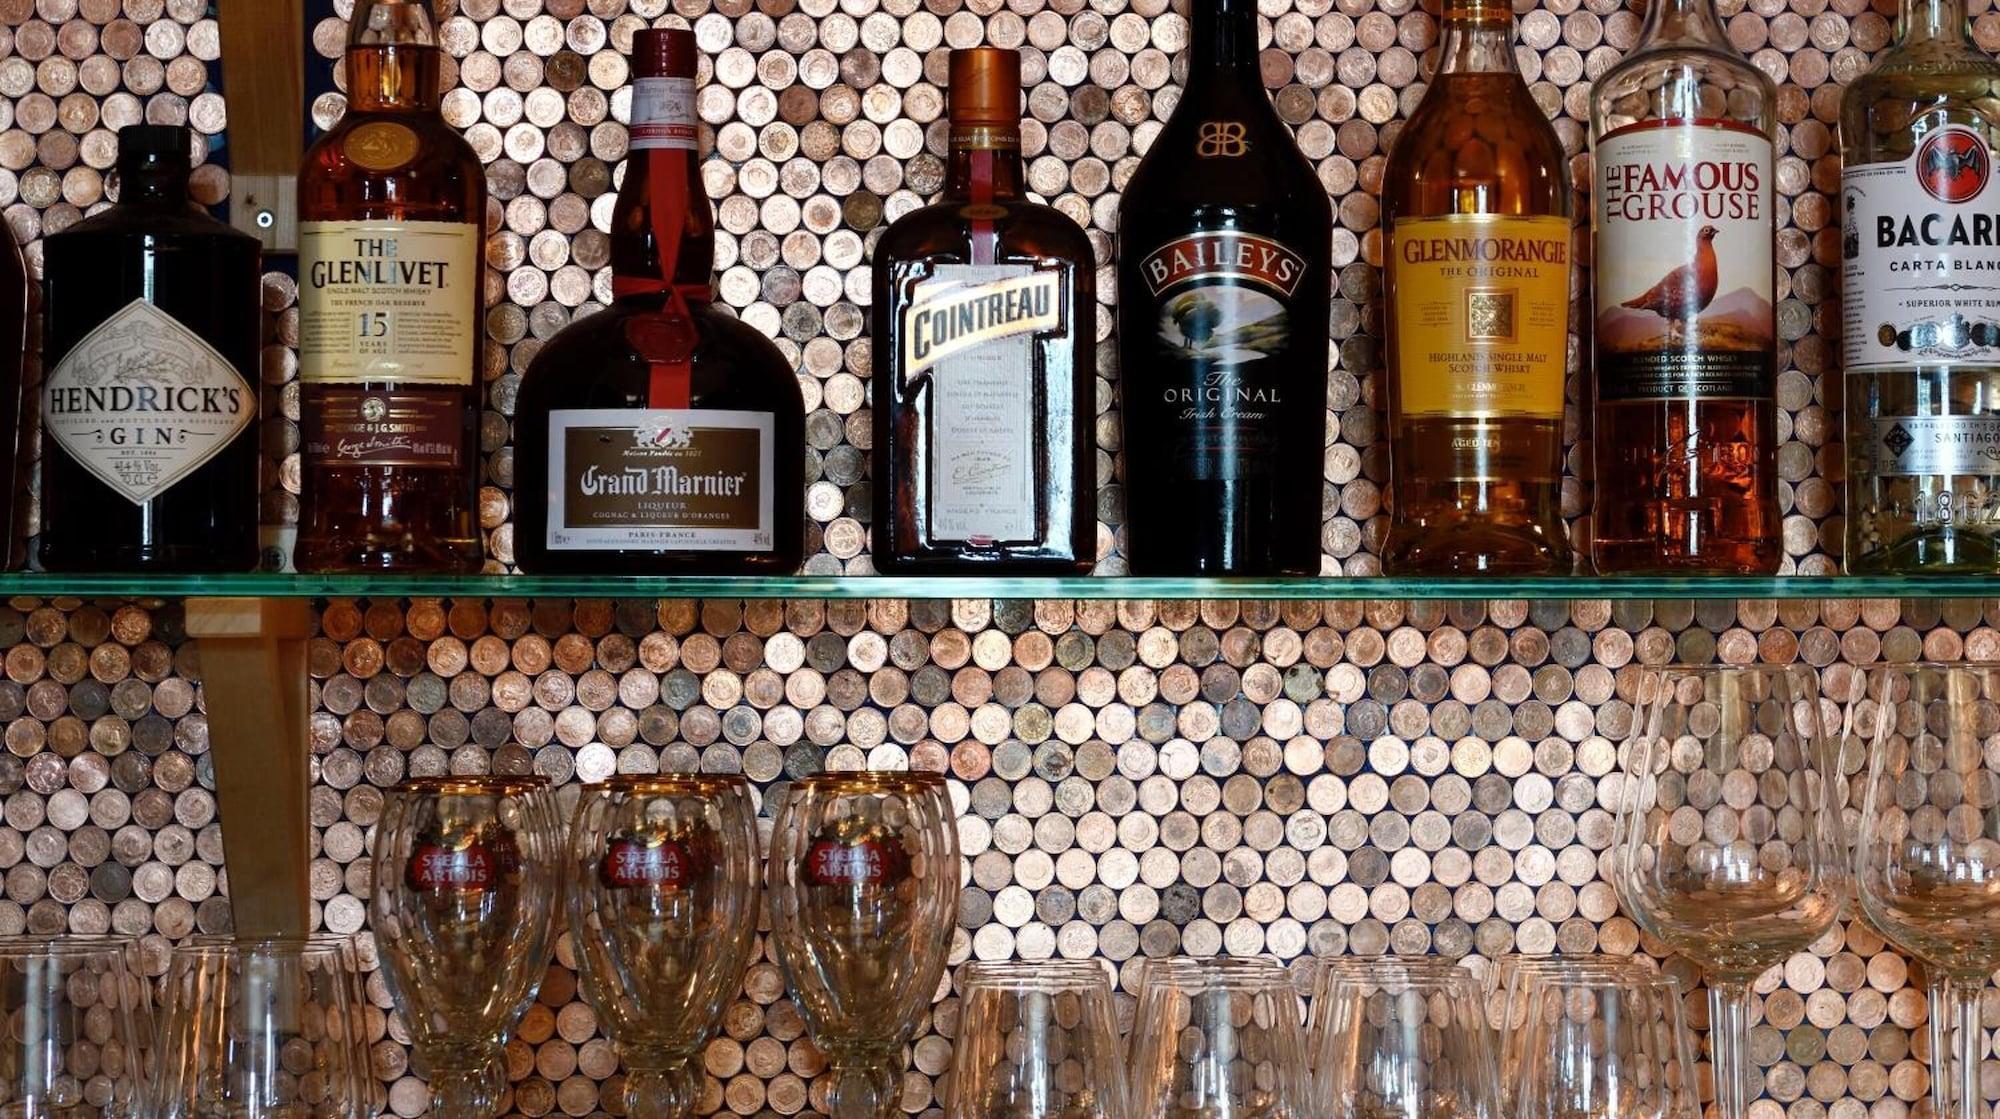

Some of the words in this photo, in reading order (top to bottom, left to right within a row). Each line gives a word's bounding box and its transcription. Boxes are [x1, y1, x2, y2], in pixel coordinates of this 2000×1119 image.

[1623, 161, 1760, 192] FAMOUS
[1606, 165, 1622, 223] THE
[1622, 192, 1760, 221] GROUSE
[1877, 213, 2000, 248] BACAR
[353, 238, 398, 258] THE
[1404, 238, 1567, 264] GLENMORANGIE
[1150, 241, 1295, 285] BAILEYS
[1889, 260, 1945, 272] CARTA
[311, 261, 449, 289] GLENLIVET
[1440, 267, 1462, 277] THE
[1467, 266, 1539, 278] ORIGINAL
[1906, 299, 1951, 308] SUPERIOR
[1954, 299, 1982, 308] WHITE
[359, 312, 388, 338] 15
[914, 285, 1051, 360] COINTREAU
[1495, 364, 1531, 374] WHISKY
[1203, 371, 1243, 386] The
[50, 385, 242, 414] HENDRICK'S
[1163, 387, 1280, 402] ORIGINAL
[1179, 406, 1216, 419] Irish
[1220, 406, 1266, 419] Cream
[389, 423, 416, 433] SMITH
[110, 428, 173, 445] GIN
[1452, 437, 1480, 449] AGED
[580, 465, 649, 496] Grand
[652, 465, 744, 496] Marnier
[637, 502, 689, 510] LIQUEUR
[422, 854, 486, 866] STELLA
[615, 851, 679, 864] STELLA
[421, 869, 488, 882] ARTOIS
[614, 866, 680, 879] ARTOIS
[817, 864, 882, 879] ARTOIS
